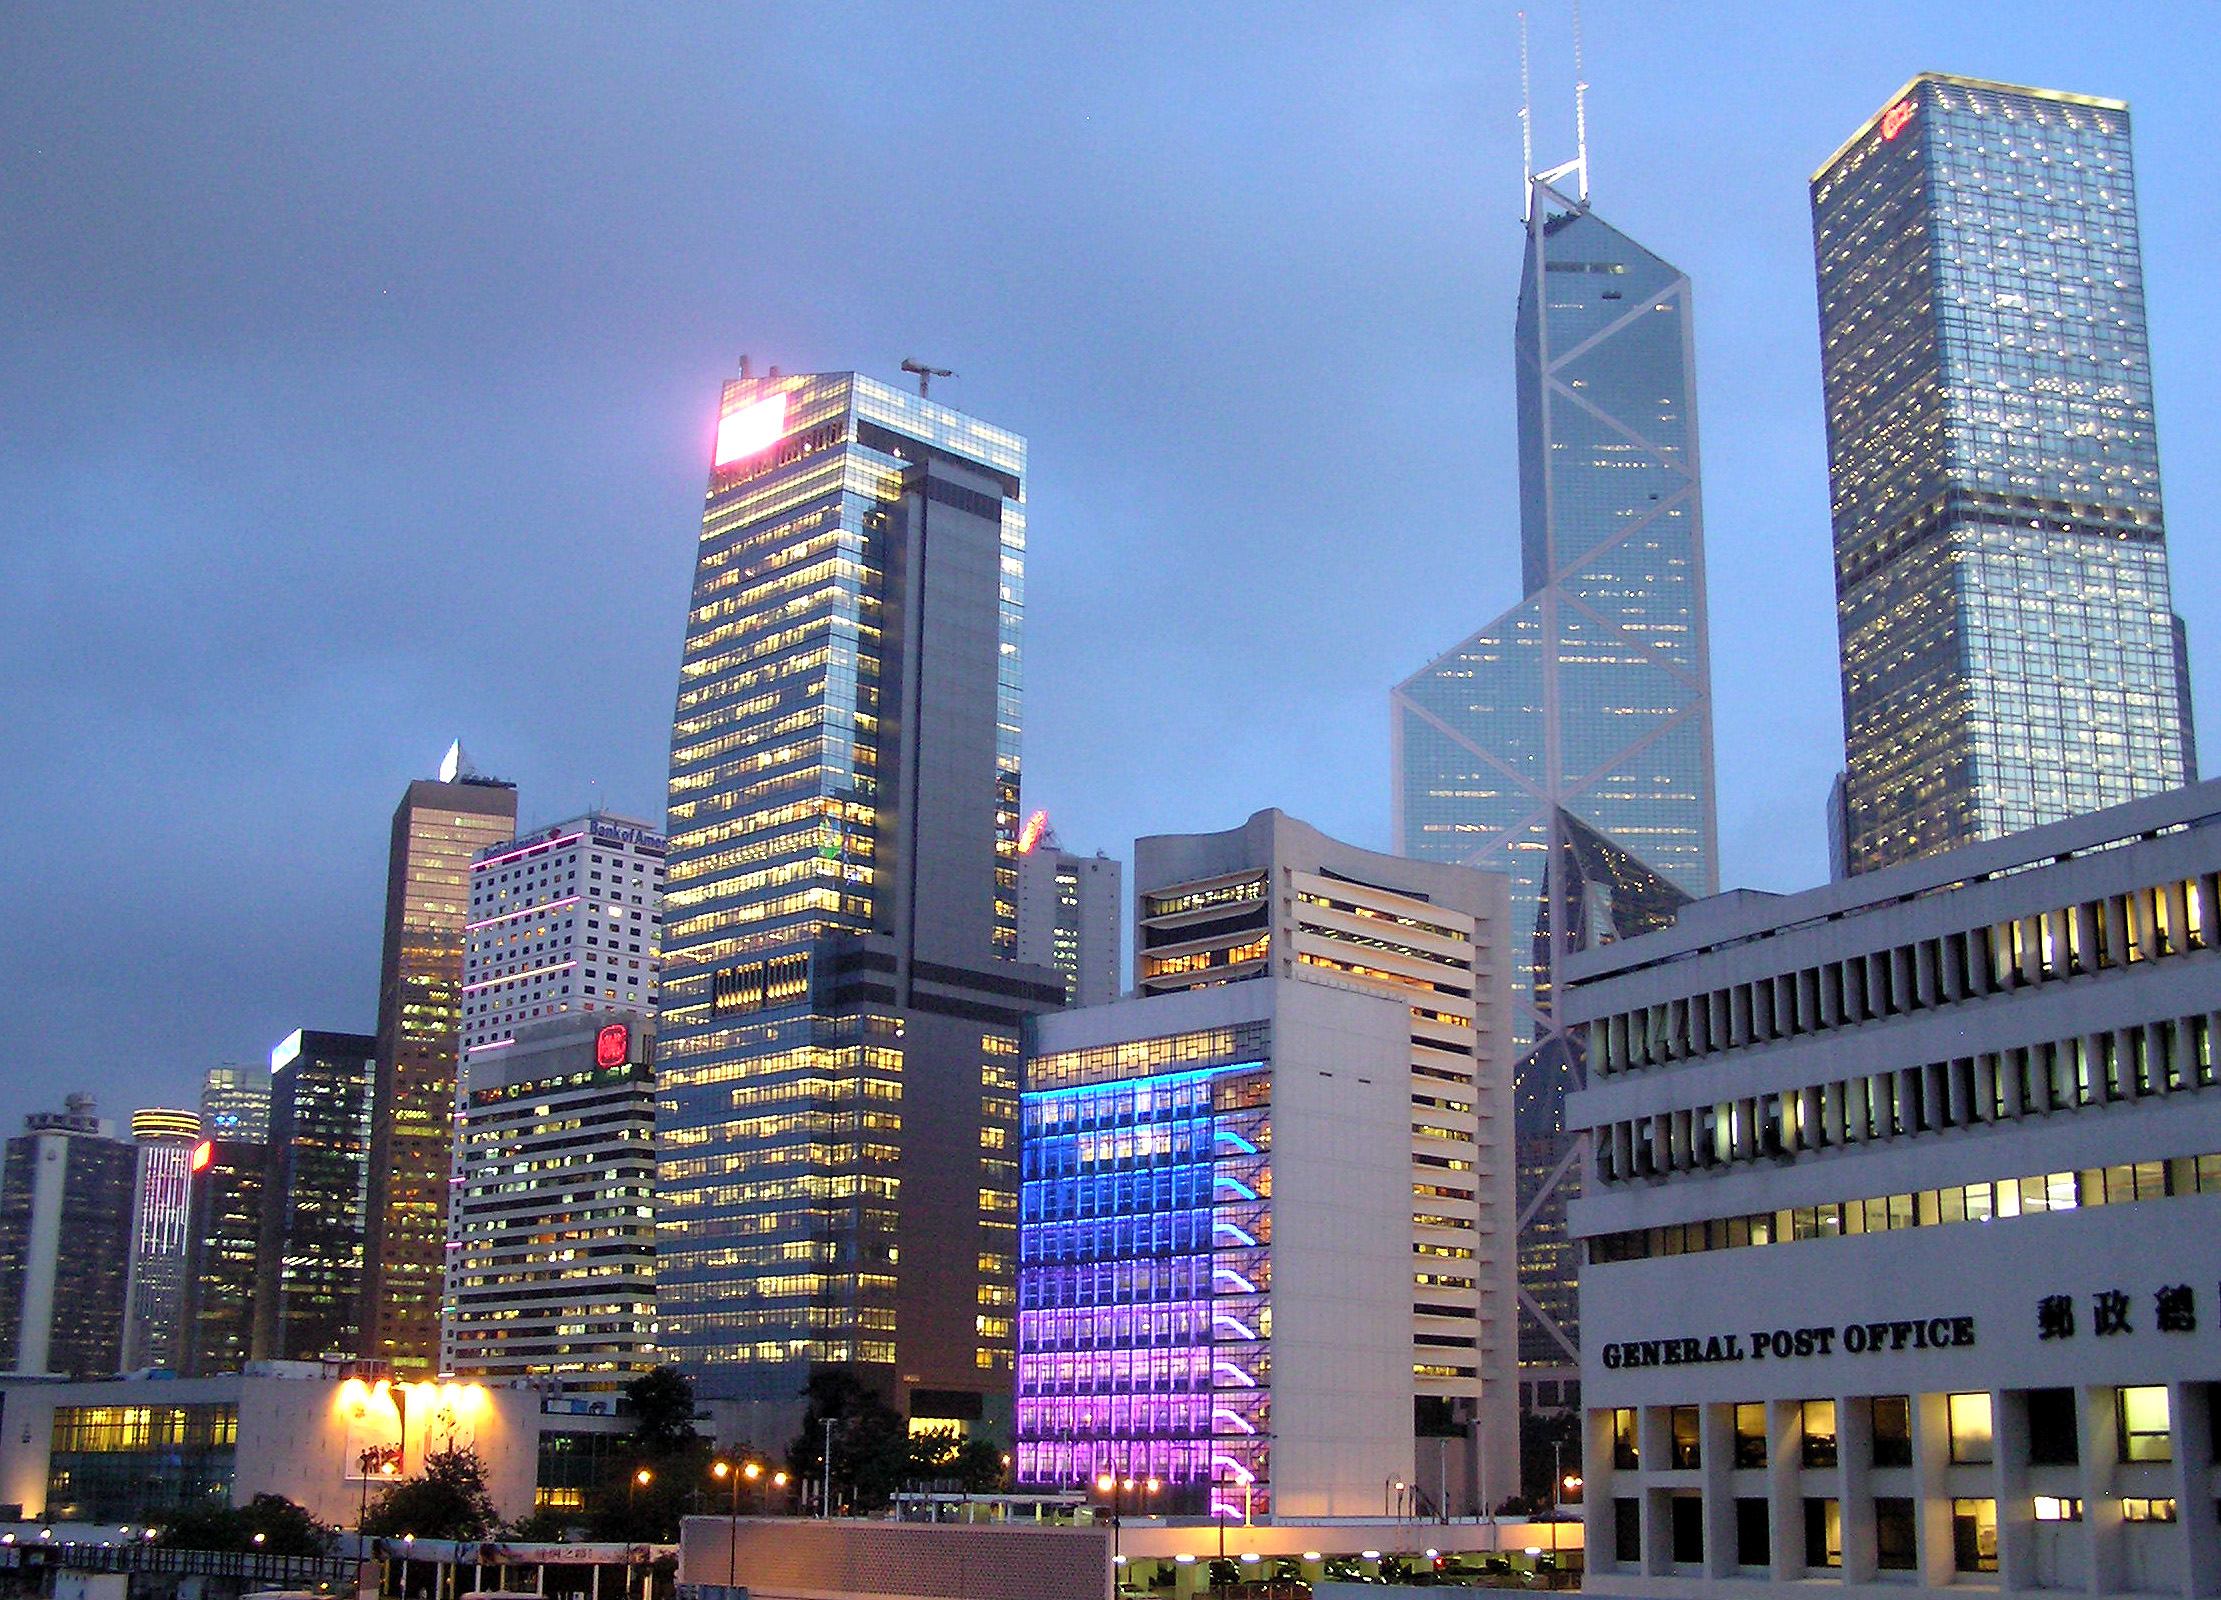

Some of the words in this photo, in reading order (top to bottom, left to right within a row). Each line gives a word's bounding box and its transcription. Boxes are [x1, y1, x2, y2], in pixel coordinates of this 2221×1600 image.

[591, 819, 619, 841] Bank
[621, 828, 635, 843] of
[2036, 1282, 2221, 1341] 郵政總
[1602, 1334, 1744, 1369] GENERAL
[1750, 1327, 1835, 1359] POST
[1843, 1316, 1975, 1354] OFFICE
